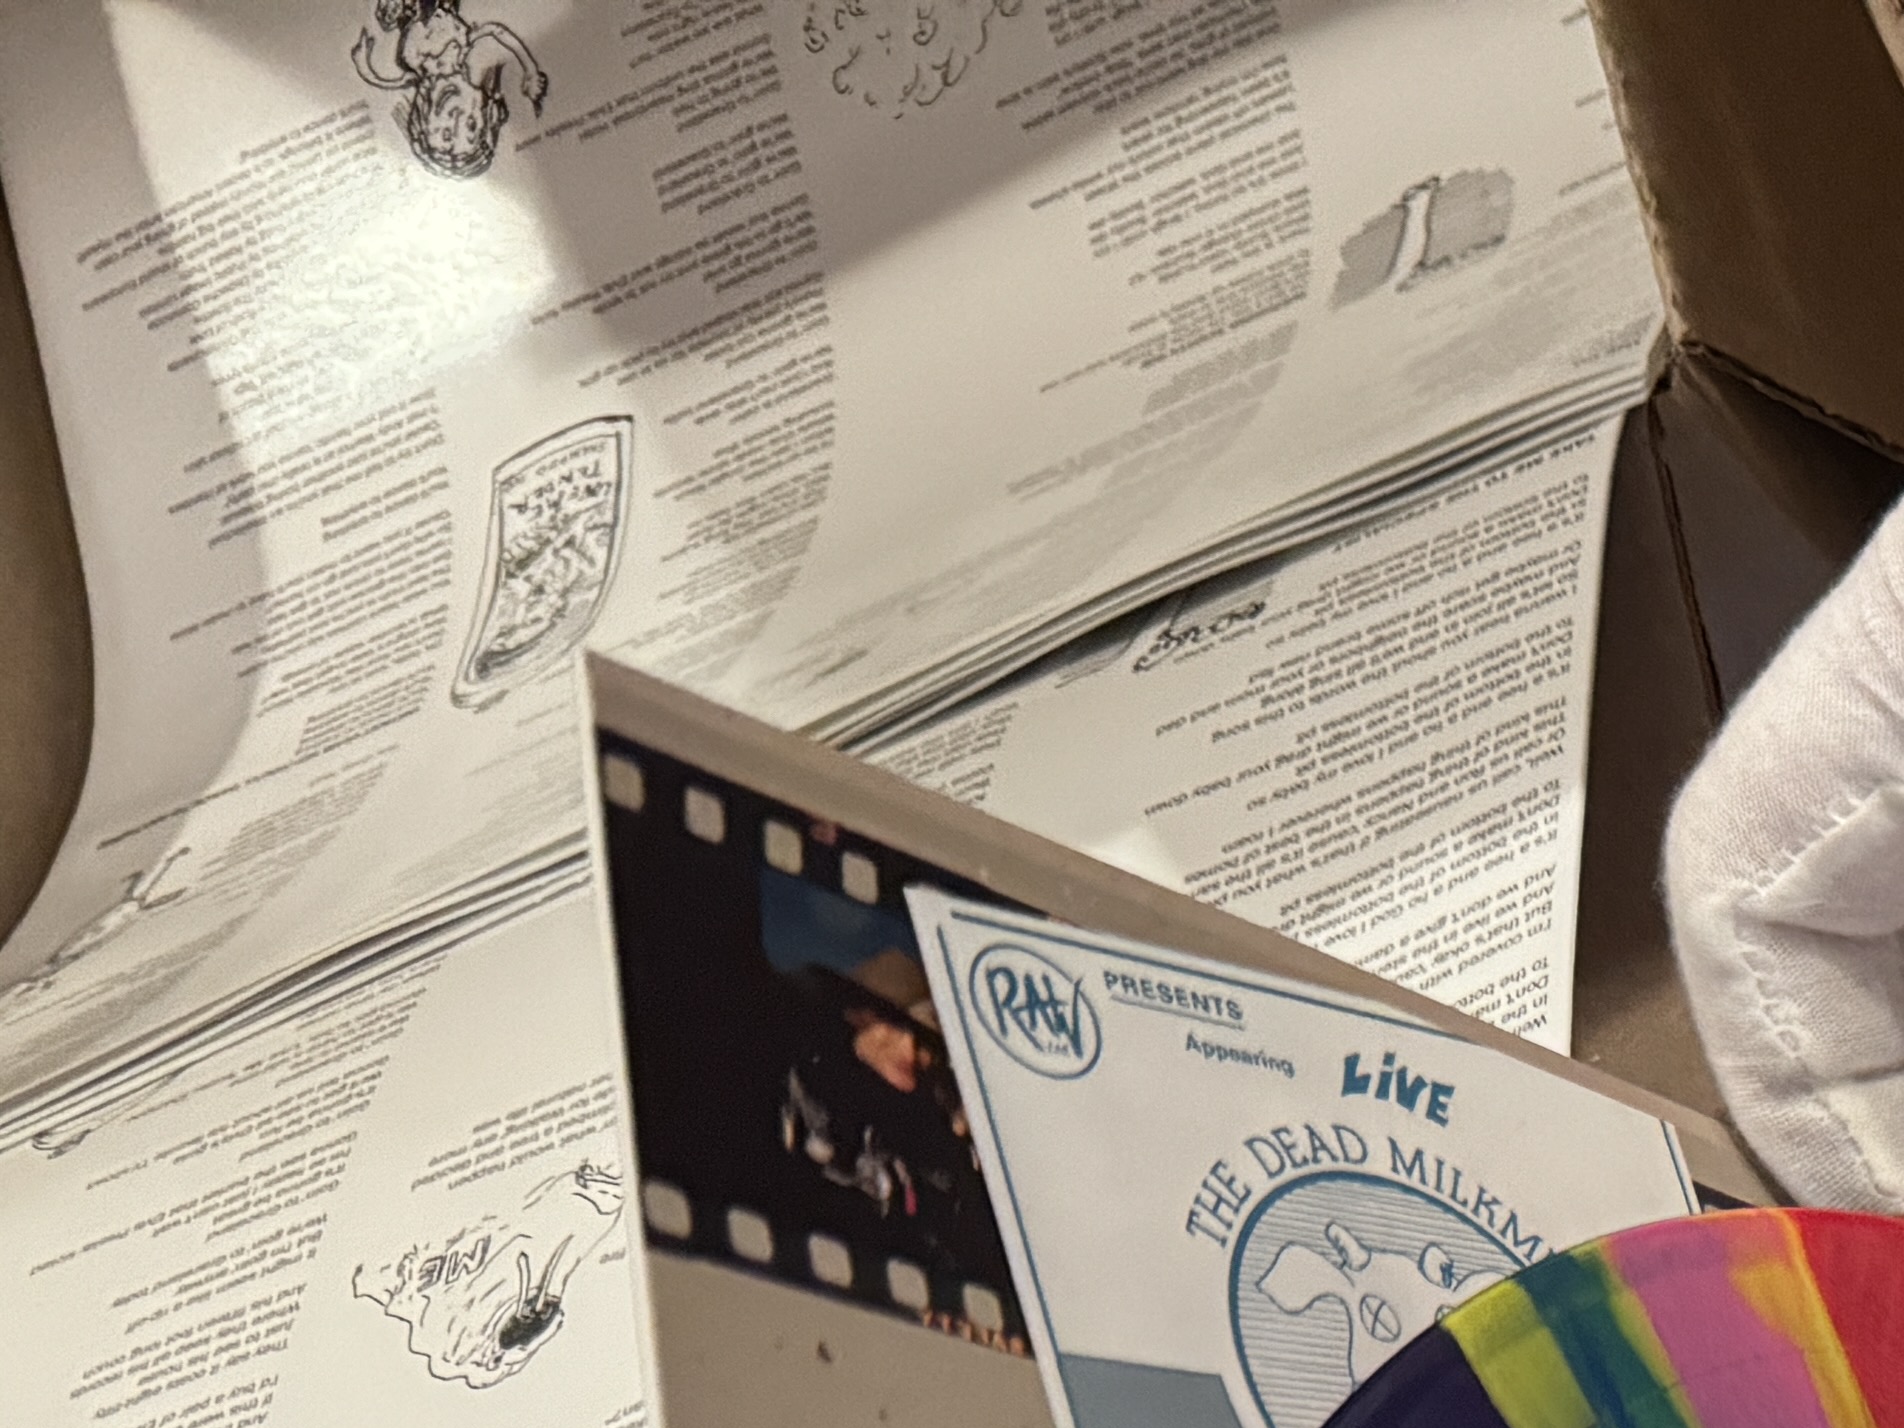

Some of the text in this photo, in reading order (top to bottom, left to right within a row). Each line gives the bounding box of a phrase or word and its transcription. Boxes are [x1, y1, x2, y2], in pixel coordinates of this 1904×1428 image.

[1104, 969, 1244, 1020] PRESENTS
[1186, 1033, 1296, 1078] Appearing
[1186, 1122, 1561, 1262] THE DEAD MILKM
